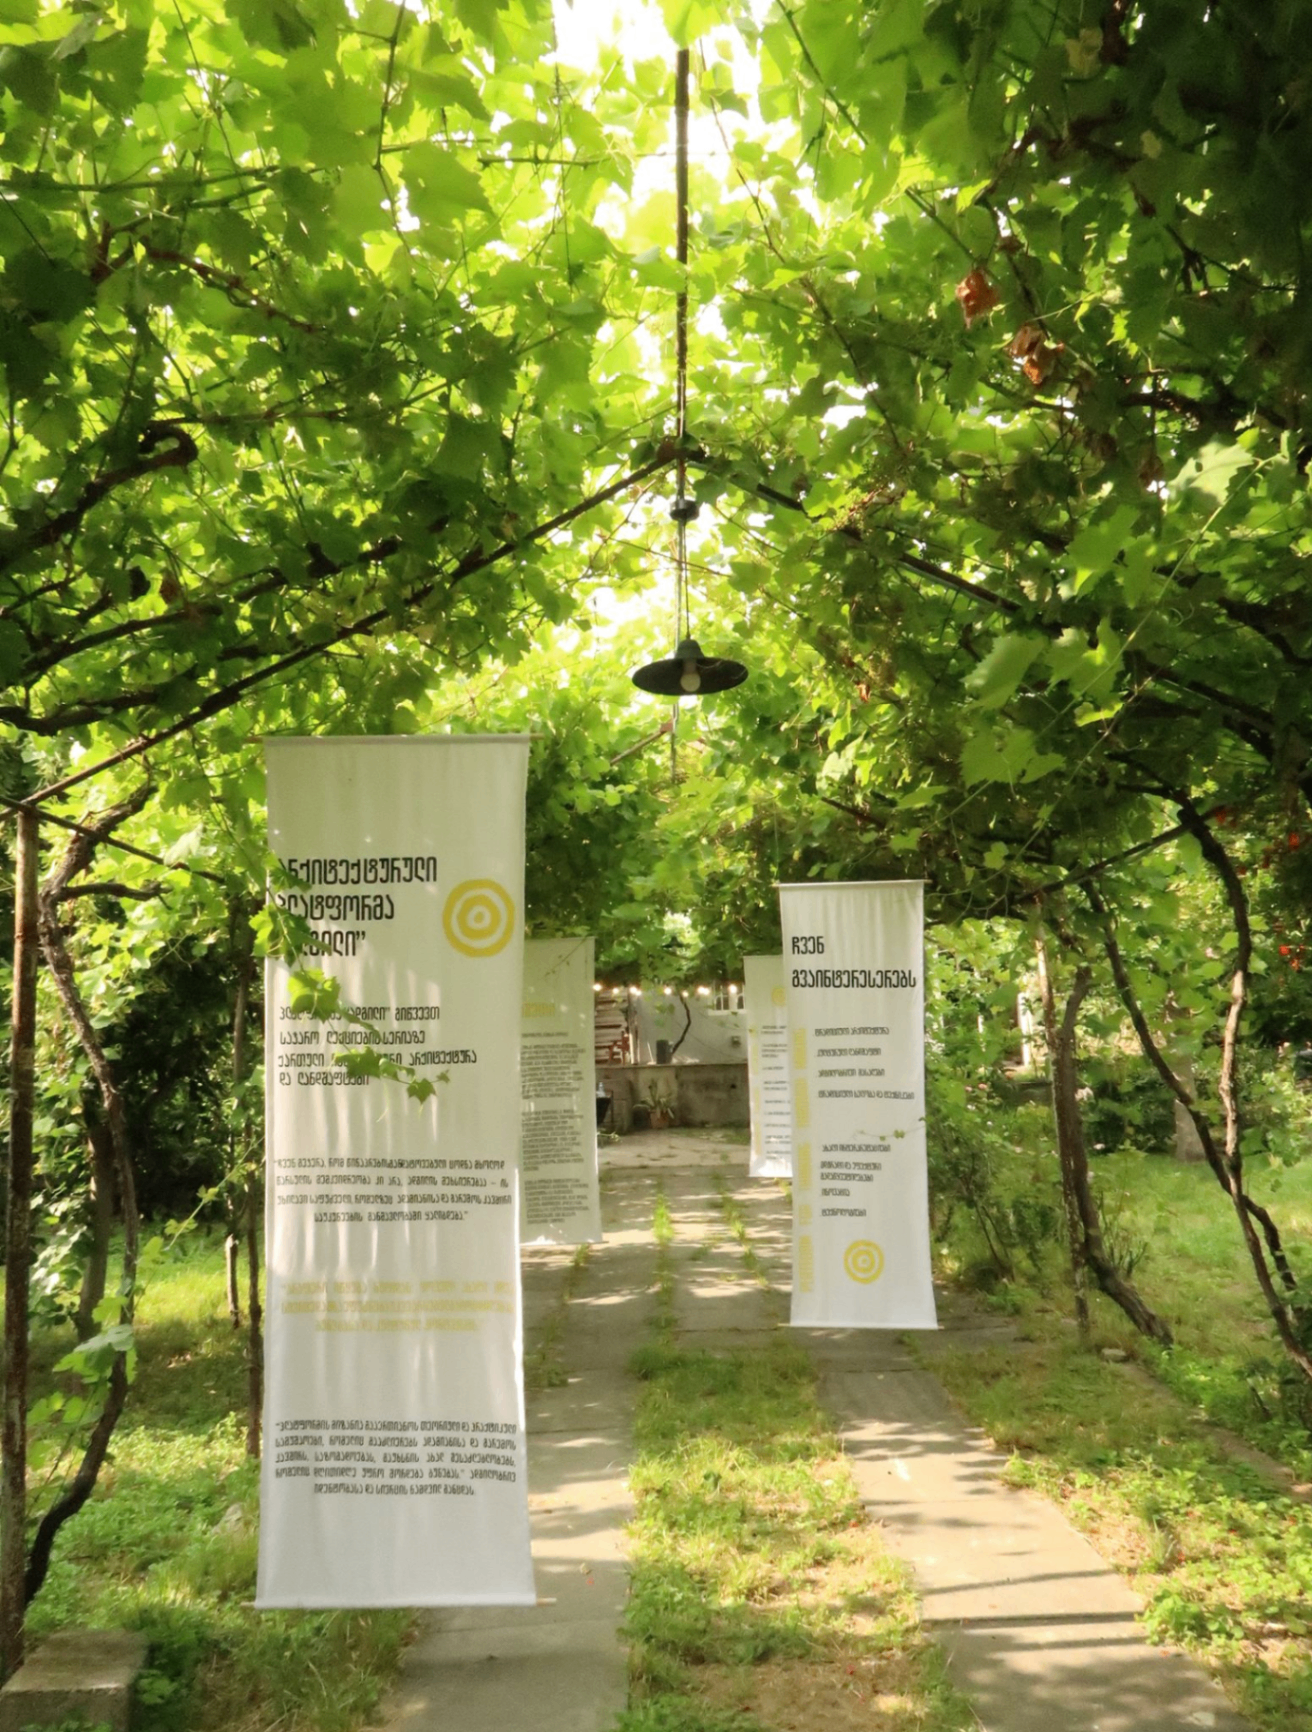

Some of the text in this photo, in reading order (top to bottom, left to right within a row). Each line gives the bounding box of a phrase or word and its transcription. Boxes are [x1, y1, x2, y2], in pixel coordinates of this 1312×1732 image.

[791, 936, 825, 955] ჩვენ
[791, 969, 917, 988] გვაინტერესერებს
[394, 1006, 440, 1021] გიწვევთ
[280, 1030, 320, 1045] საჯარო
[383, 1030, 425, 1045] სერიაზე
[278, 1052, 324, 1067] ქართული
[409, 1050, 477, 1066] არქიტექტურა
[279, 1071, 291, 1086] და
[328, 1157, 345, 1168] რომ
[469, 1437, 479, 1448] და
